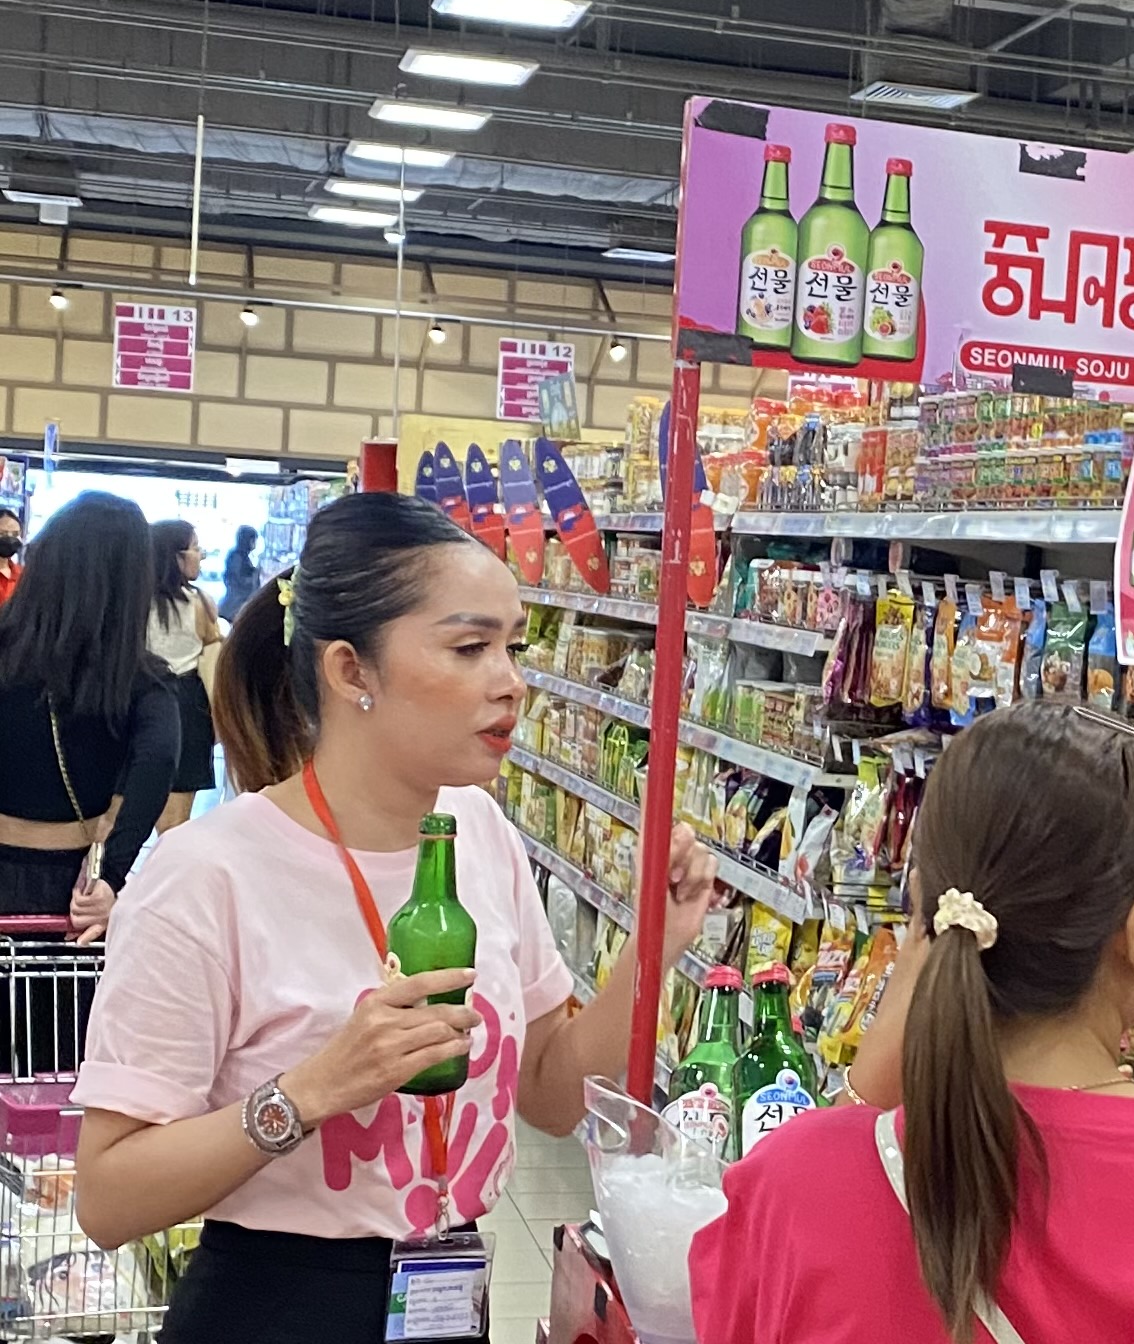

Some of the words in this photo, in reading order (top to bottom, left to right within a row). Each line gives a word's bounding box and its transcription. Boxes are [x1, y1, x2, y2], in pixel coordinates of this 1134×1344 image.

[173, 310, 193, 322] 13
[552, 345, 572, 358] 12
[1076, 356, 1131, 380] SOJU
[759, 1090, 809, 1105] SEONMUL
